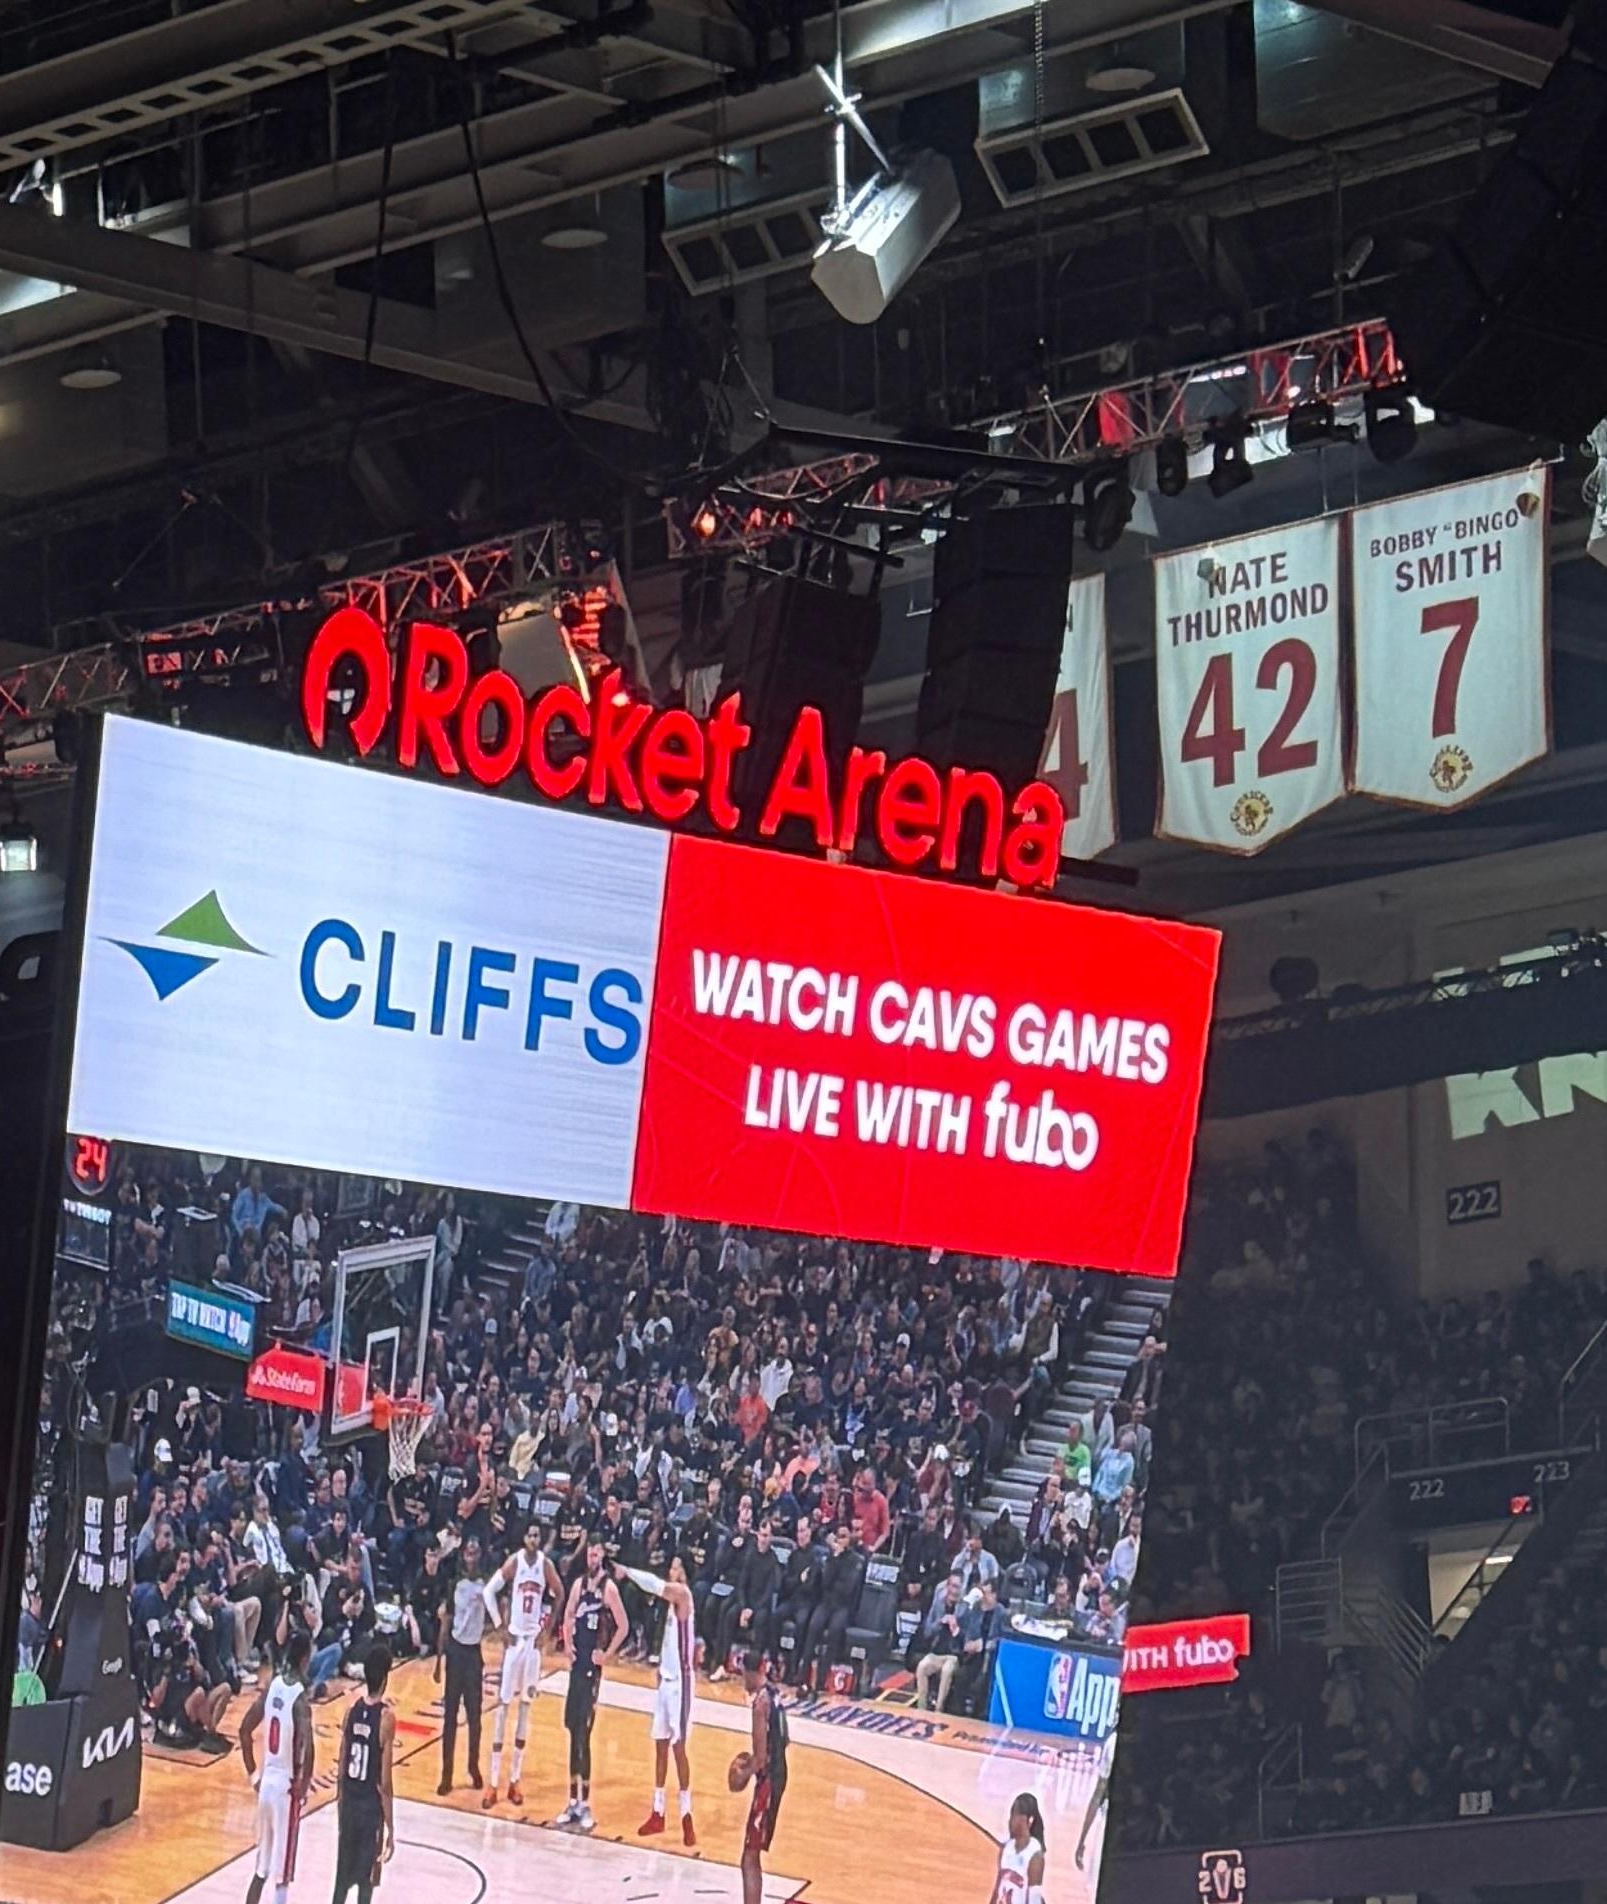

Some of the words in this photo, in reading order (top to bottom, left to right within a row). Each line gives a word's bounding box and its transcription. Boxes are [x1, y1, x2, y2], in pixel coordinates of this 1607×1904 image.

[1370, 525, 1438, 558] BOBBY
[1395, 540, 1503, 593] SMITH
[1209, 552, 1288, 599] NATE
[1167, 582, 1328, 648] THURMOND
[1420, 596, 1479, 739] 7
[1181, 638, 1318, 788] 42
[400, 621, 751, 829] Rocket
[758, 705, 1066, 890] Arena
[299, 918, 644, 1066] CLIFFS
[691, 949, 860, 1040] WATCH
[867, 978, 1000, 1060] CAVS
[1008, 1004, 1170, 1085] GAMES
[744, 1065, 841, 1139] LIVE
[853, 1080, 969, 1156] WITH
[984, 1081, 1099, 1173] fubo
[75, 1138, 108, 1182] 24
[1450, 1187, 1500, 1219] 222
[1121, 1641, 1169, 1674] ITH
[1173, 1633, 1235, 1670] fubo
[1066, 1656, 1122, 1738] App
[5, 1758, 53, 1796] ase
[347, 1743, 370, 1782] 31
